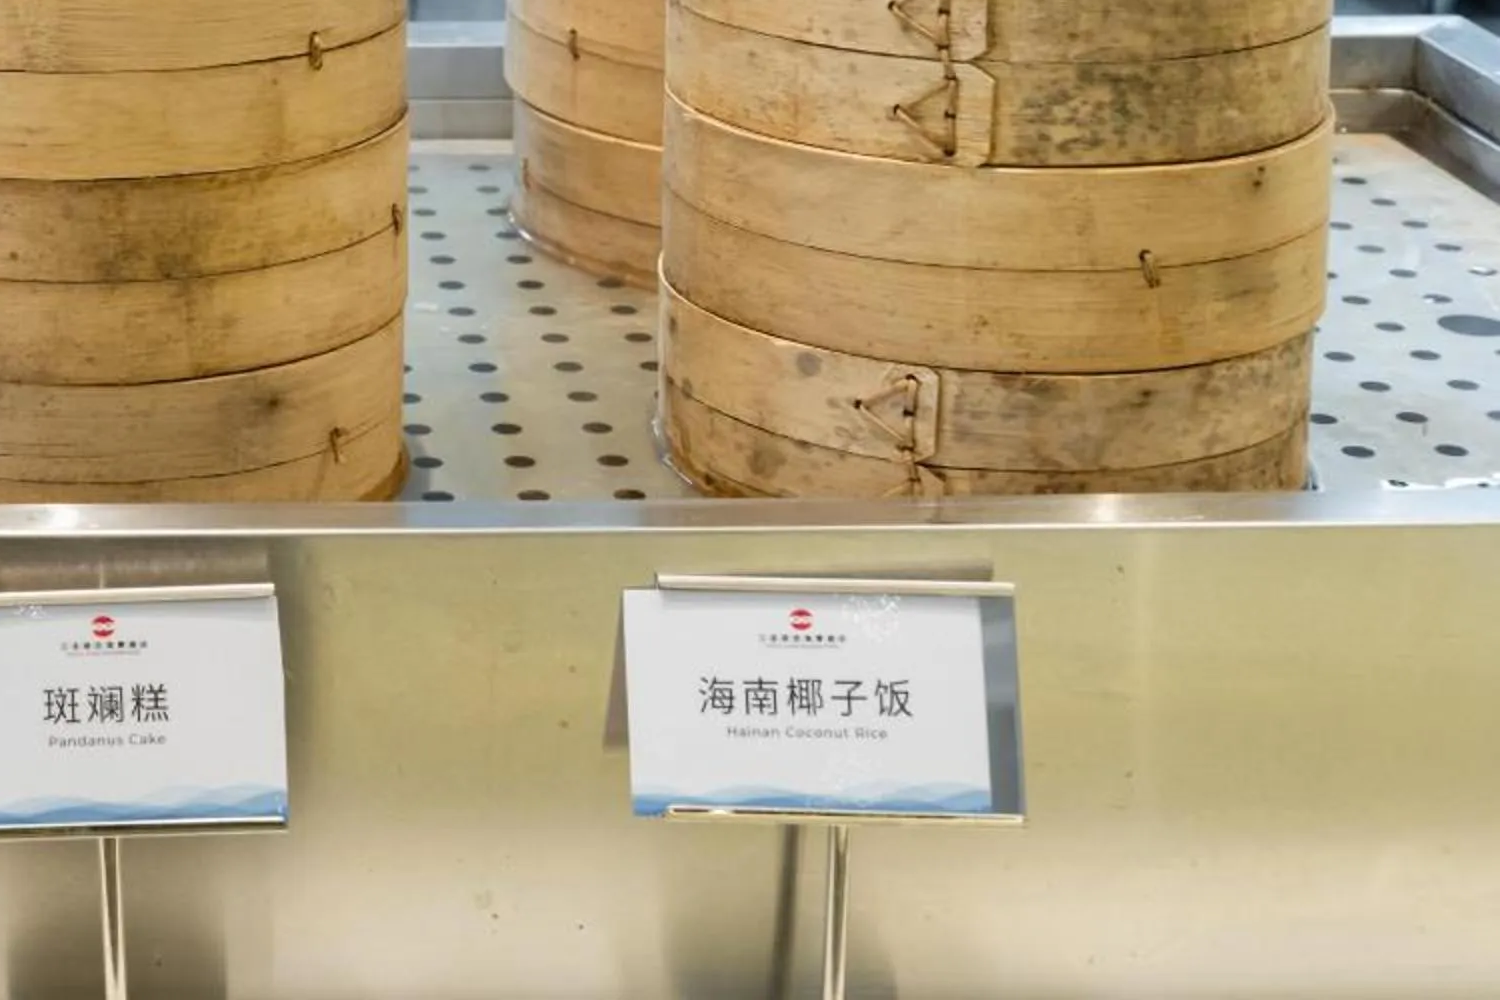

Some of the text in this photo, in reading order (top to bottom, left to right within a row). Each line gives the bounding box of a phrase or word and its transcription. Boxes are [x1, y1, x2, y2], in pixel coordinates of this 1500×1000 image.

[43, 683, 169, 724] 斑斓糕
[698, 676, 913, 717] 海南椰子饭
[48, 733, 167, 748] Pandanus Cake
[727, 726, 888, 739] Hainan Coconut Rice
